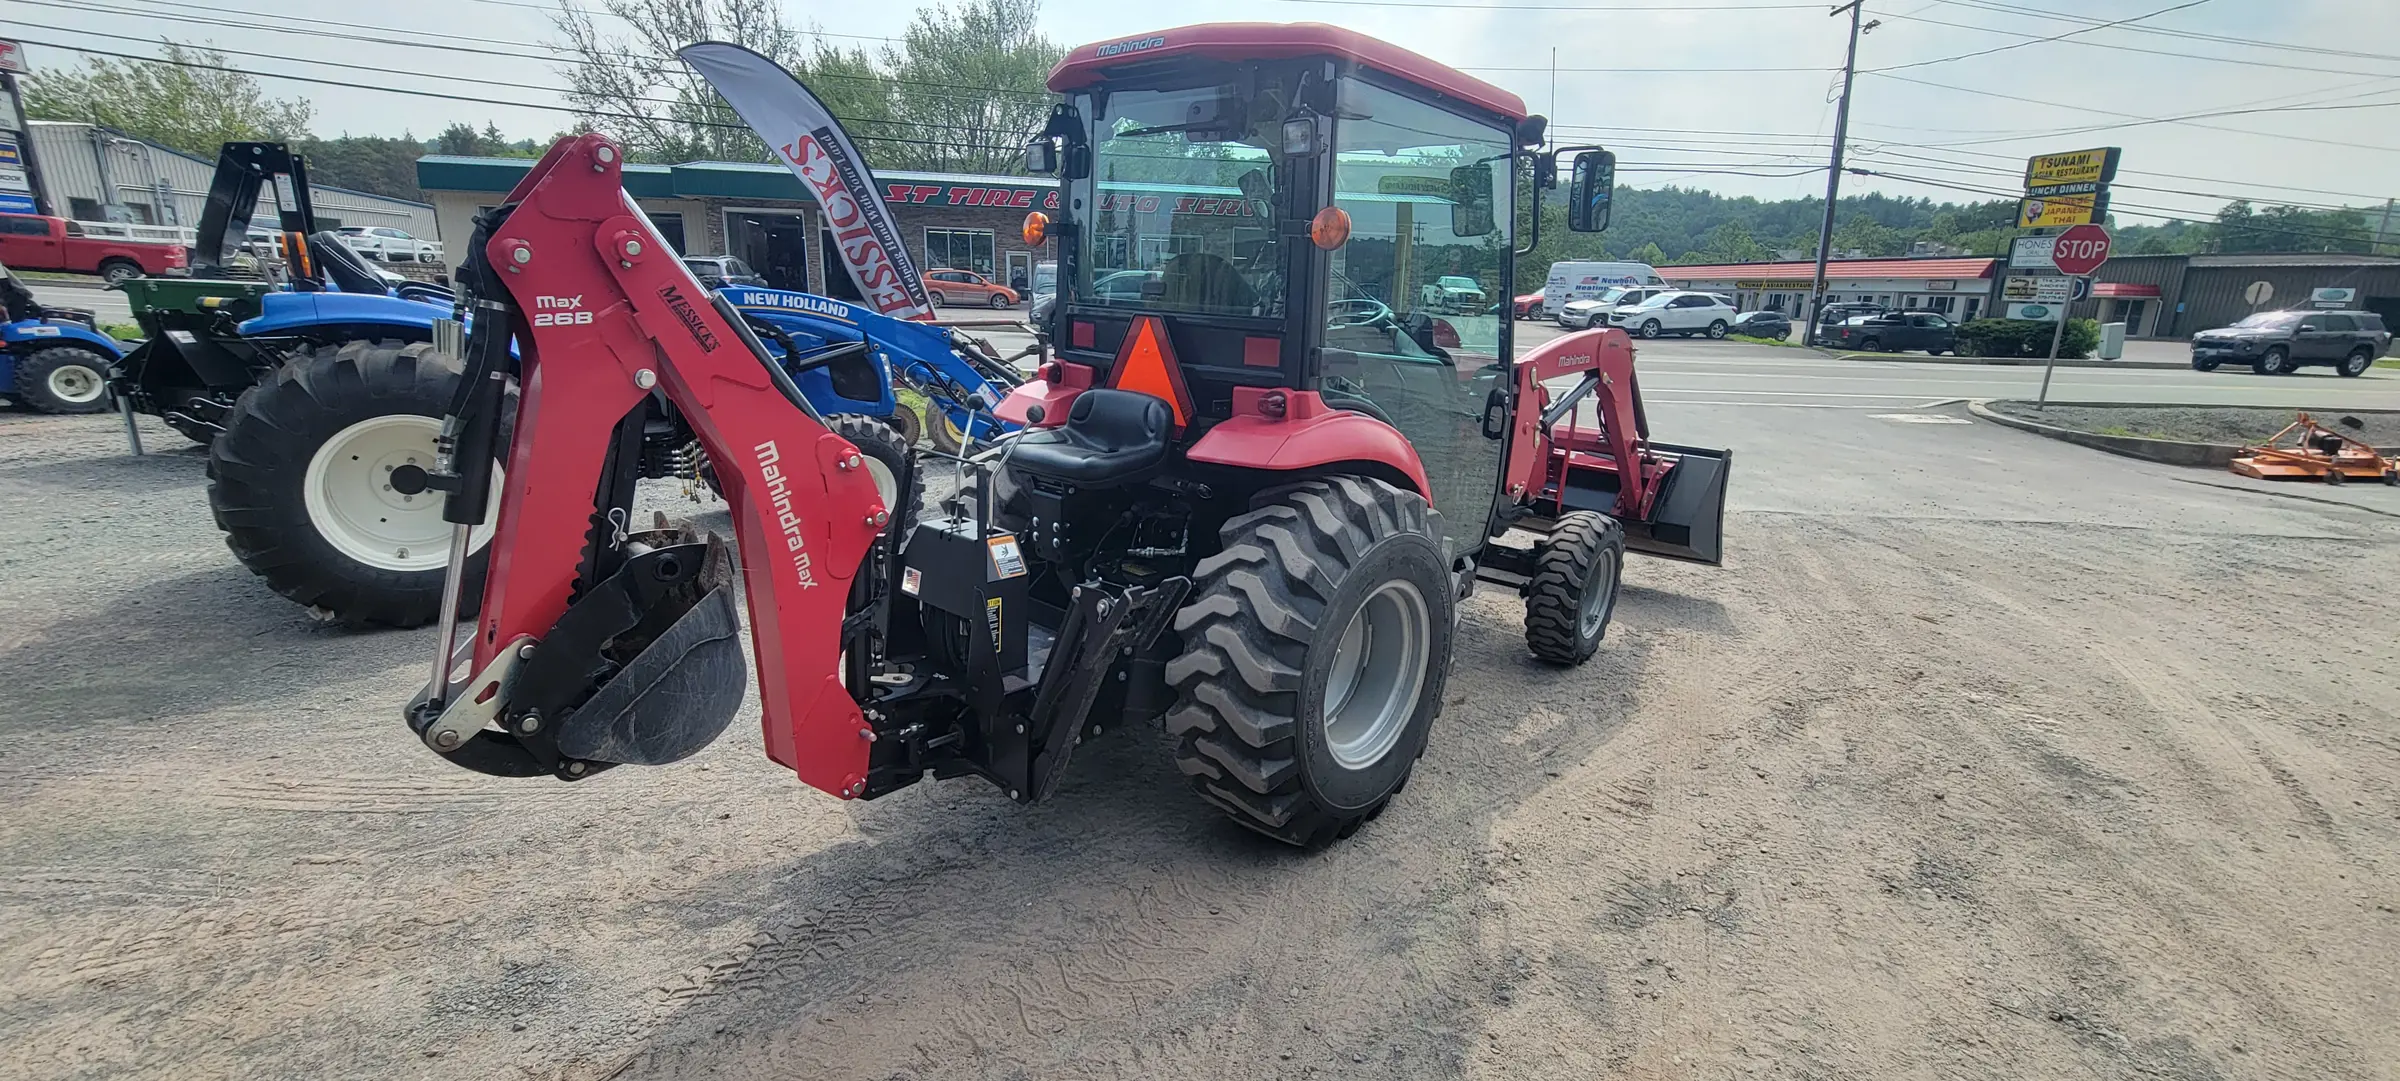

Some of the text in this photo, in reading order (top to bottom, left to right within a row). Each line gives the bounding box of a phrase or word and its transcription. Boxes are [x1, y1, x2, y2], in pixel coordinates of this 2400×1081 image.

[1096, 36, 1165, 57] Mahindra
[2040, 154, 2091, 169] TSUNAMI
[2056, 165, 2100, 177] RESTAURANT
[2026, 183, 2097, 197] LUNCH DINNER
[948, 187, 1037, 208] TIRE
[1043, 191, 1060, 209] &
[1096, 193, 1161, 213] UTO
[820, 134, 925, 301] A Helping Hand With Your Land
[2045, 206, 2089, 216] JAPANESE
[781, 135, 922, 319] ESSICK'S
[2053, 216, 2076, 224] THAI
[2017, 239, 2053, 249] HONES
[2056, 240, 2107, 259] STOP
[743, 292, 849, 318] NEW HOLLAND
[534, 311, 593, 327] 26B
[1558, 353, 1591, 368] Mahindra
[754, 440, 804, 552] Mahindra
